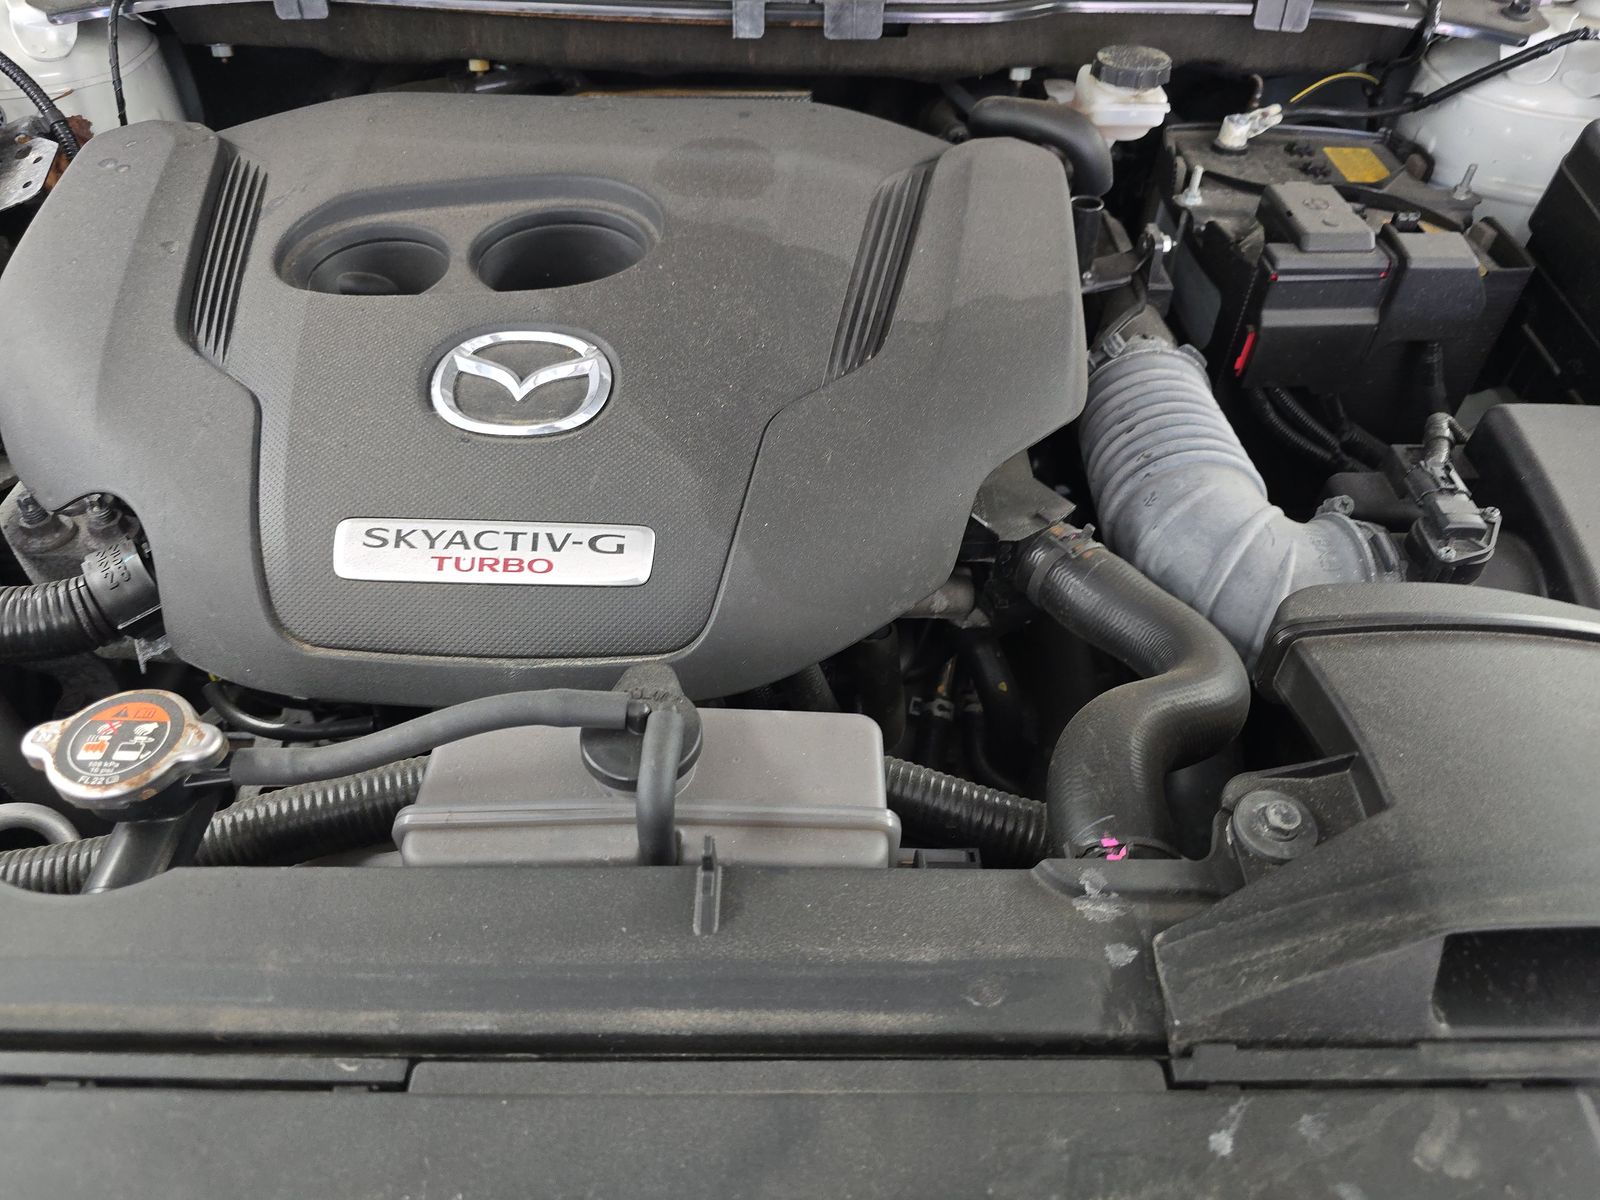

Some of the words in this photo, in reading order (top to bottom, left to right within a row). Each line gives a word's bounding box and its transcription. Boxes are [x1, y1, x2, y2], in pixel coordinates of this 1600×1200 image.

[362, 527, 626, 555] SKYACTIV-G
[431, 555, 554, 574] TURBO
[77, 775, 106, 785] FL22
